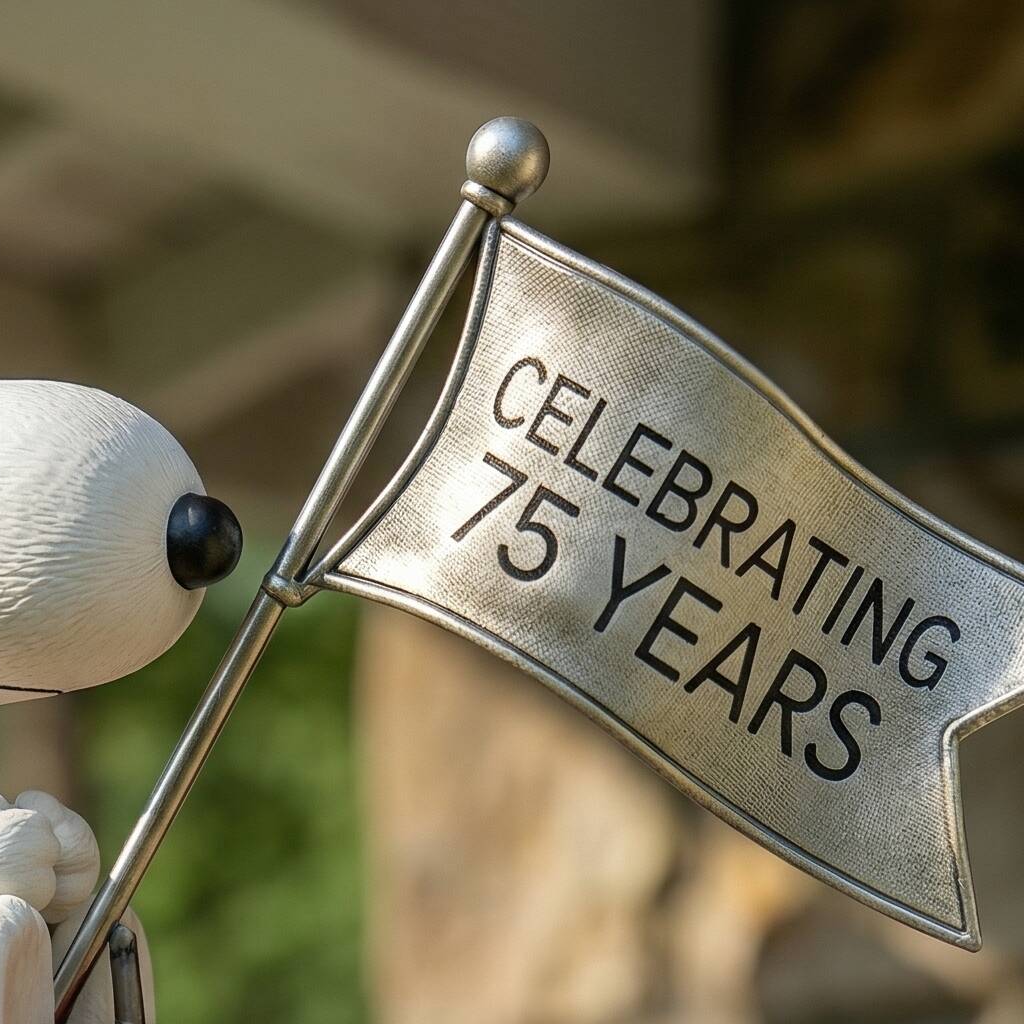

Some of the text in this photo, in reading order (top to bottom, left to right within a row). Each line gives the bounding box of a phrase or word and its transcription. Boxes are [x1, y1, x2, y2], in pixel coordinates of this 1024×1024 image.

[451, 453, 882, 782] 75 YEARS
[492, 356, 961, 691] CELEBRATING
